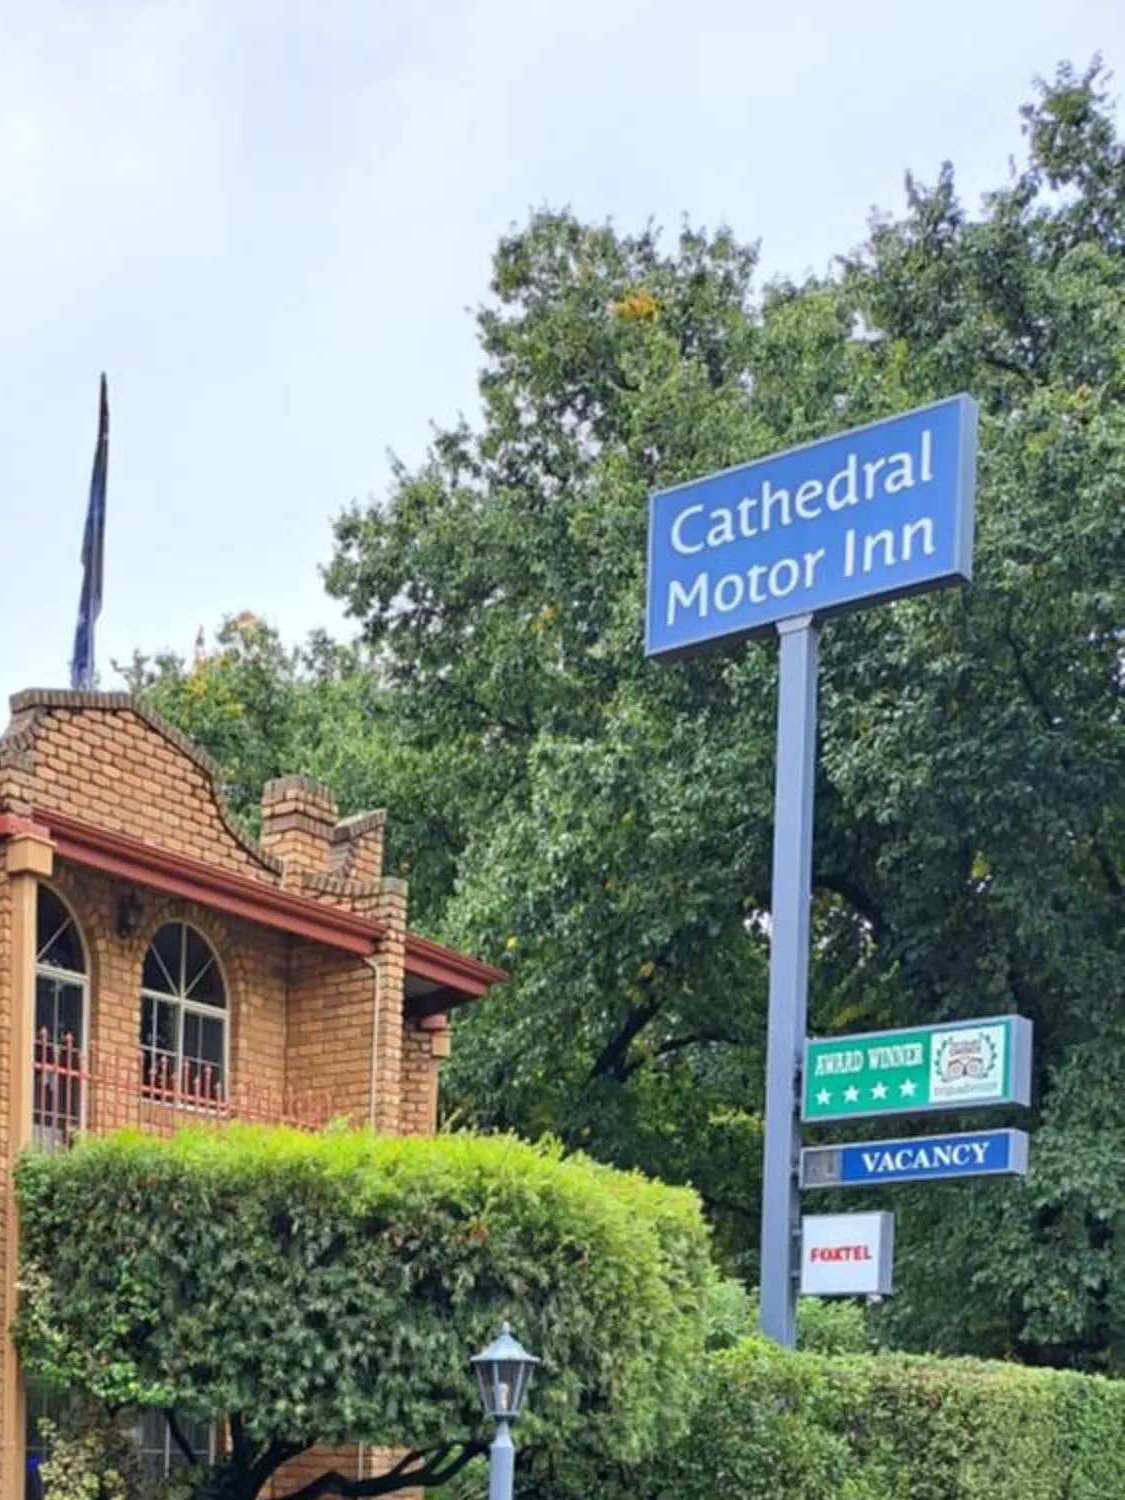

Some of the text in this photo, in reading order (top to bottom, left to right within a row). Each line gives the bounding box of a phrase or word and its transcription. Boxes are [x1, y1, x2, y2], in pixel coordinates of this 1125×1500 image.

[670, 430, 933, 556] Cathedral
[666, 516, 936, 628] Motor Inn
[815, 1050, 863, 1076] AWARD
[867, 1042, 923, 1069] WINNER
[861, 1141, 990, 1174] VACANCY
[809, 1245, 873, 1263] FOXTEL
